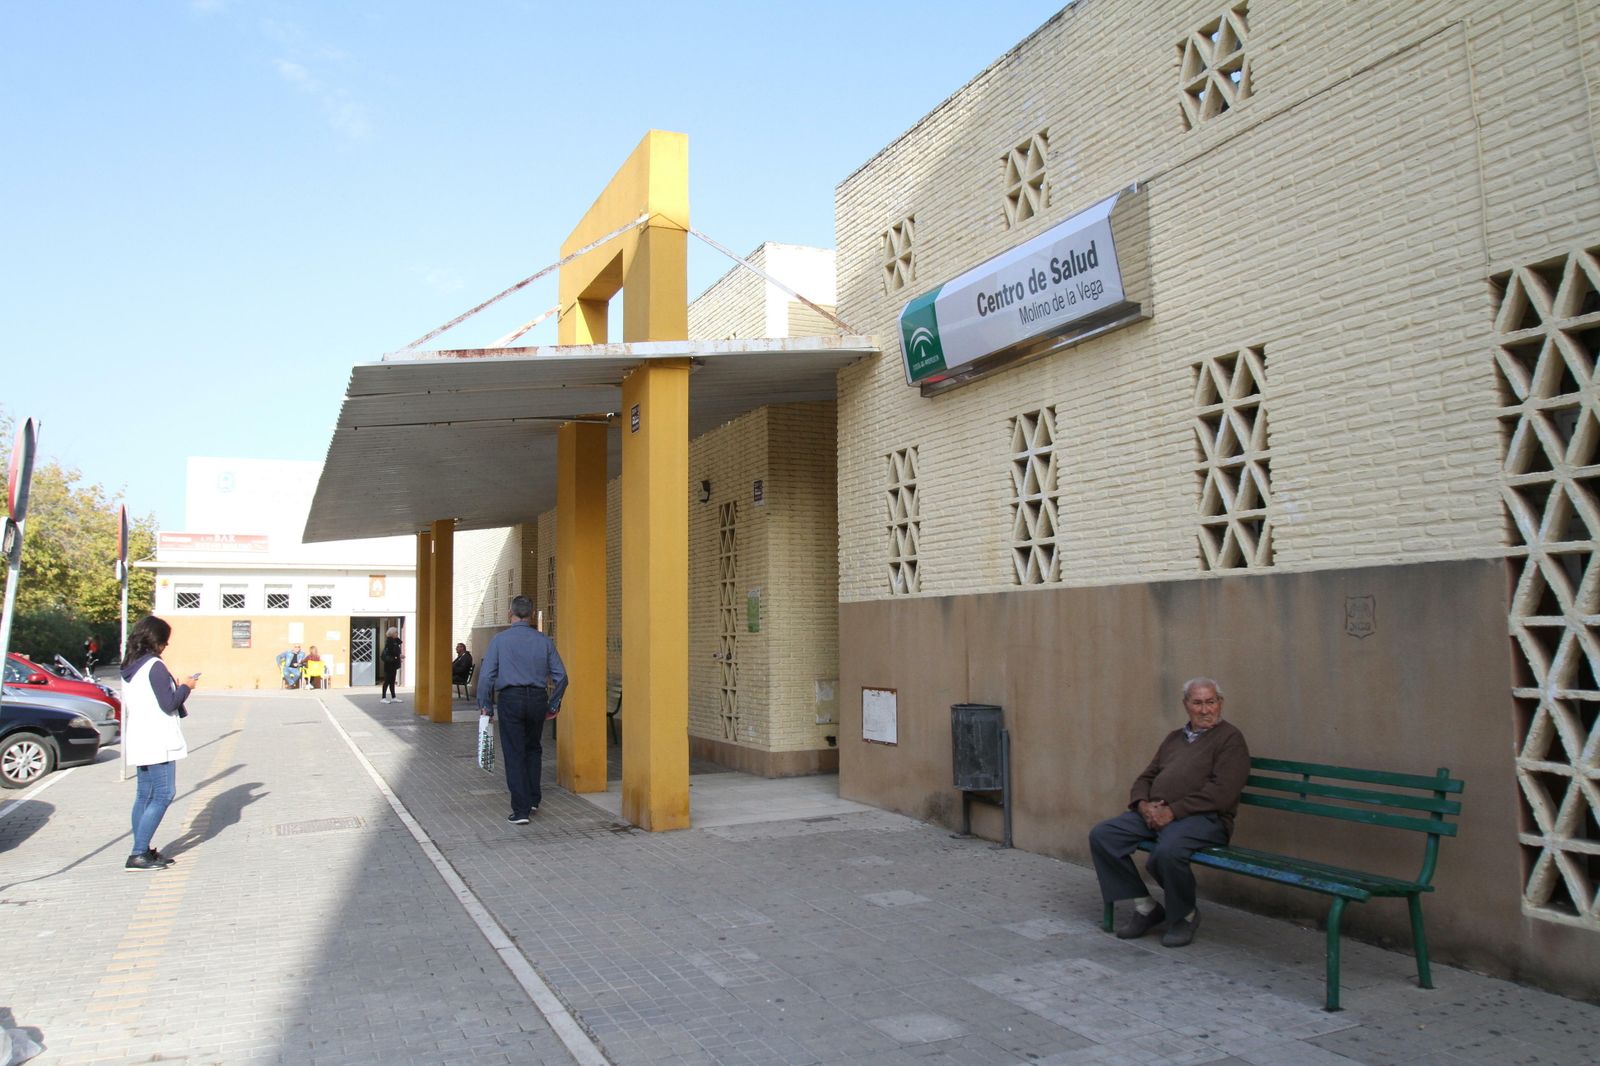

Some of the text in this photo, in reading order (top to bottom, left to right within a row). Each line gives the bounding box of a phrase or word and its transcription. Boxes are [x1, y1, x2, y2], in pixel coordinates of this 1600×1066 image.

[977, 240, 1099, 317] Centro de Salud
[1019, 279, 1104, 325] Molino de la Vega
